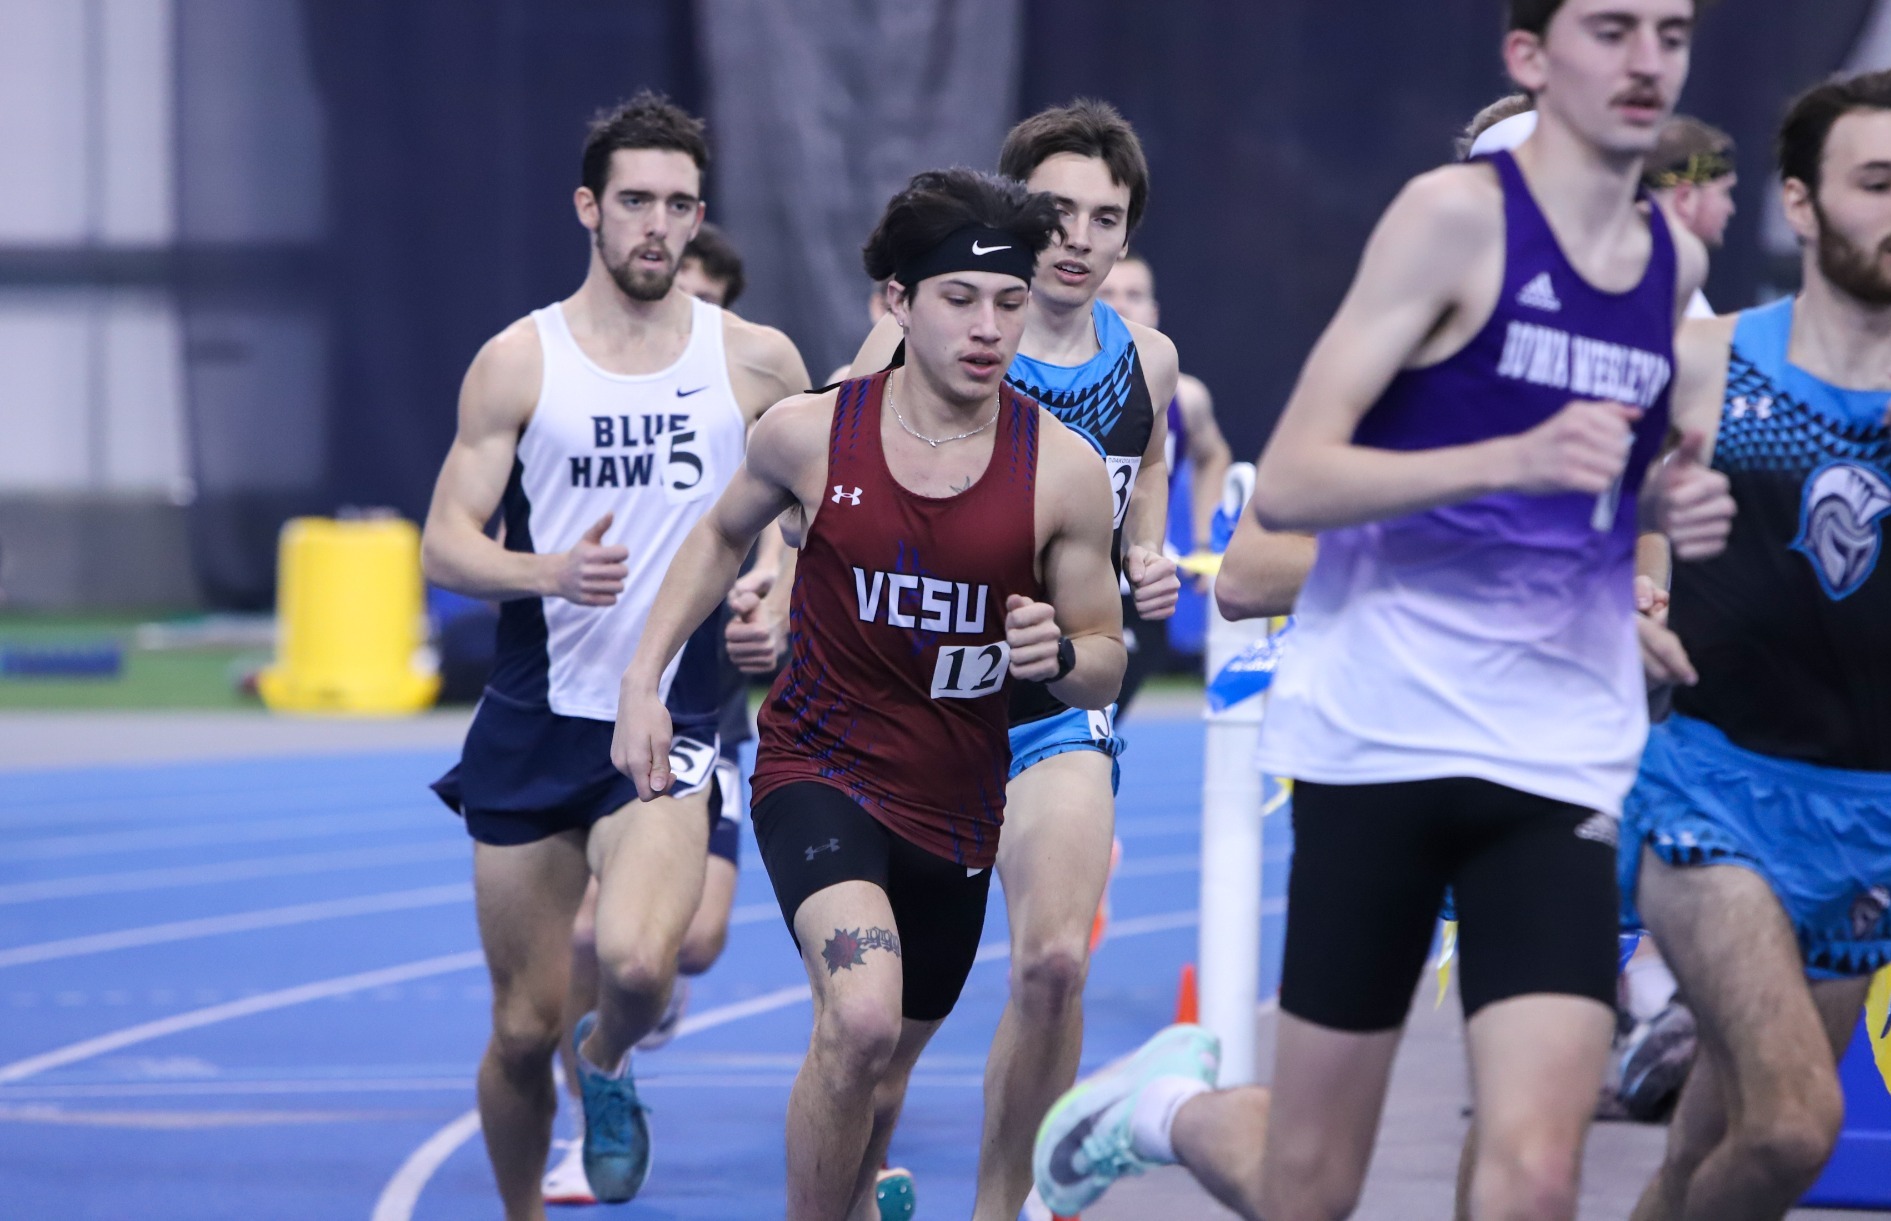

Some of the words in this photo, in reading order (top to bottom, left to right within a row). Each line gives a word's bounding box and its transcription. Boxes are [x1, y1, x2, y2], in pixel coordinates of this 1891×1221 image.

[1497, 320, 1569, 388] IOWA
[568, 454, 664, 488] HAW
[668, 431, 703, 490] 5
[1113, 464, 1132, 519] 3
[853, 567, 988, 633] VCSU
[938, 645, 1003, 691] 12
